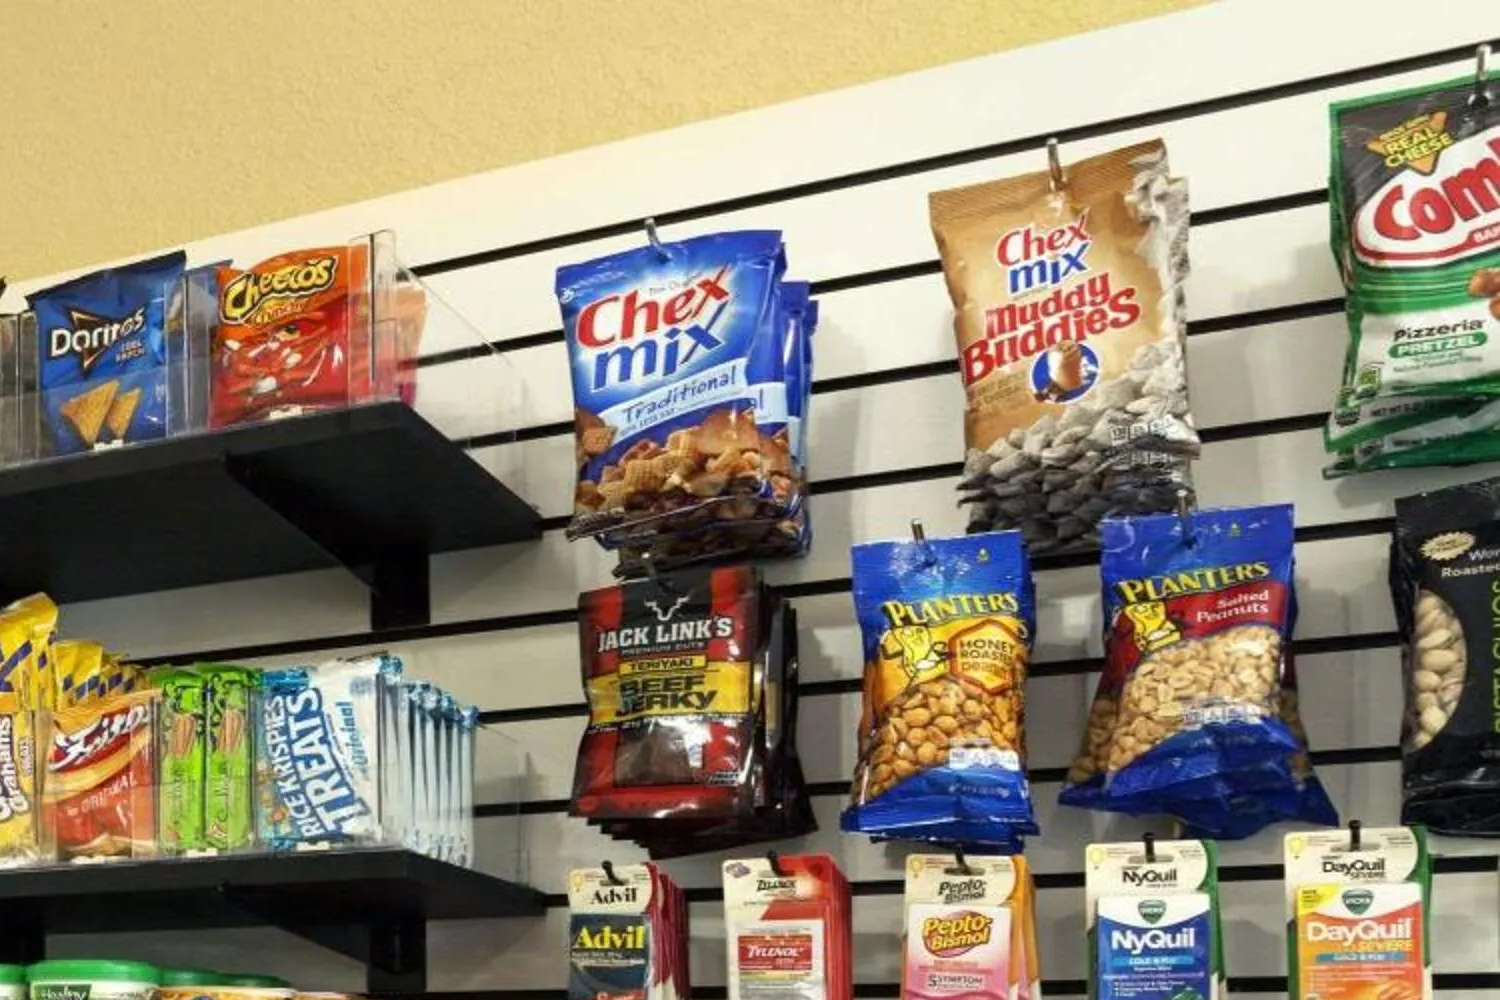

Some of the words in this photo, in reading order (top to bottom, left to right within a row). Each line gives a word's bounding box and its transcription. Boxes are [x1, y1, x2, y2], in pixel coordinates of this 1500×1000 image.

[1385, 132, 1453, 168] CHEESE
[1373, 137, 1500, 241] Com
[997, 207, 1091, 269] Chex
[1007, 242, 1090, 295] mix
[222, 256, 336, 320] Cheetos
[985, 271, 1111, 339] Muddy
[575, 263, 733, 350] Chex
[51, 307, 146, 358] Doritos
[591, 300, 729, 392] mix
[963, 286, 1142, 387] Buddies
[1394, 319, 1485, 342] Pizzeria
[622, 364, 737, 424] Traditional
[1119, 561, 1271, 603] PLANTERS
[1216, 589, 1270, 610] Salted
[882, 592, 1020, 627] PLANTERS
[1195, 603, 1270, 624] Peanuts
[597, 626, 650, 652] JACK
[655, 616, 734, 644] LINK'S
[615, 690, 718, 717] JERKY
[619, 675, 706, 697] BEEF
[264, 695, 302, 796] KRISPIES
[288, 688, 368, 834] TREATS
[284, 792, 326, 838] RICE
[1121, 868, 1178, 887] NyQuil
[1322, 857, 1386, 877] DayQuil
[590, 886, 637, 905] Advil
[938, 877, 988, 895] Pepto-
[573, 922, 646, 950] Advil
[923, 915, 994, 937] Pepto-
[931, 927, 990, 950] Bismol
[1111, 926, 1195, 955] NyQuil
[1306, 917, 1413, 946] DayQuil
